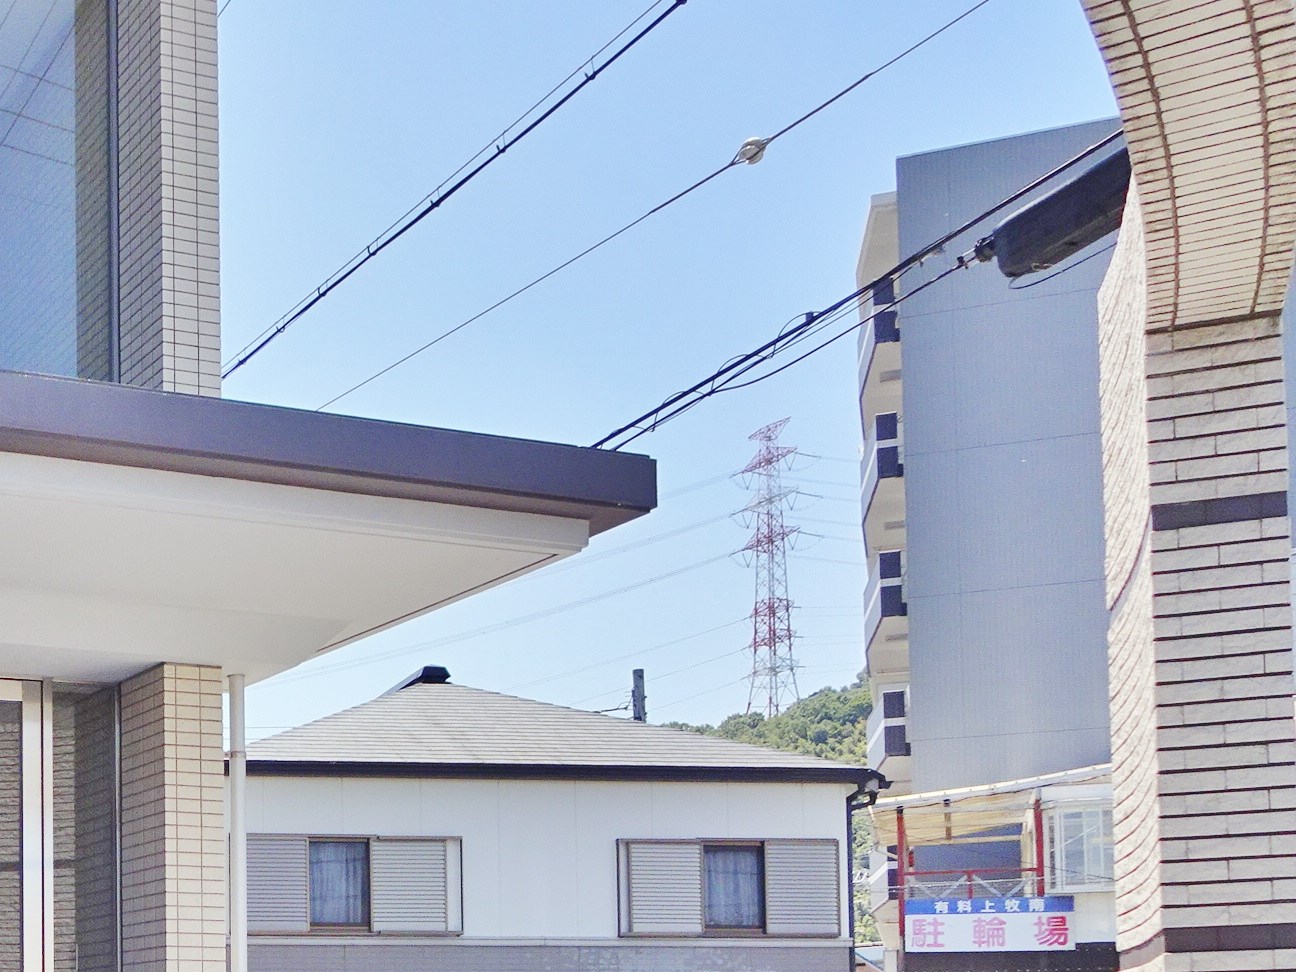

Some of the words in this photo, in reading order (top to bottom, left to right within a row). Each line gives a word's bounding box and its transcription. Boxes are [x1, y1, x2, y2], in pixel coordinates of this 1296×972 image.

[934, 899, 1045, 913] 有料上牧南
[911, 916, 1069, 948] 駐輪場
